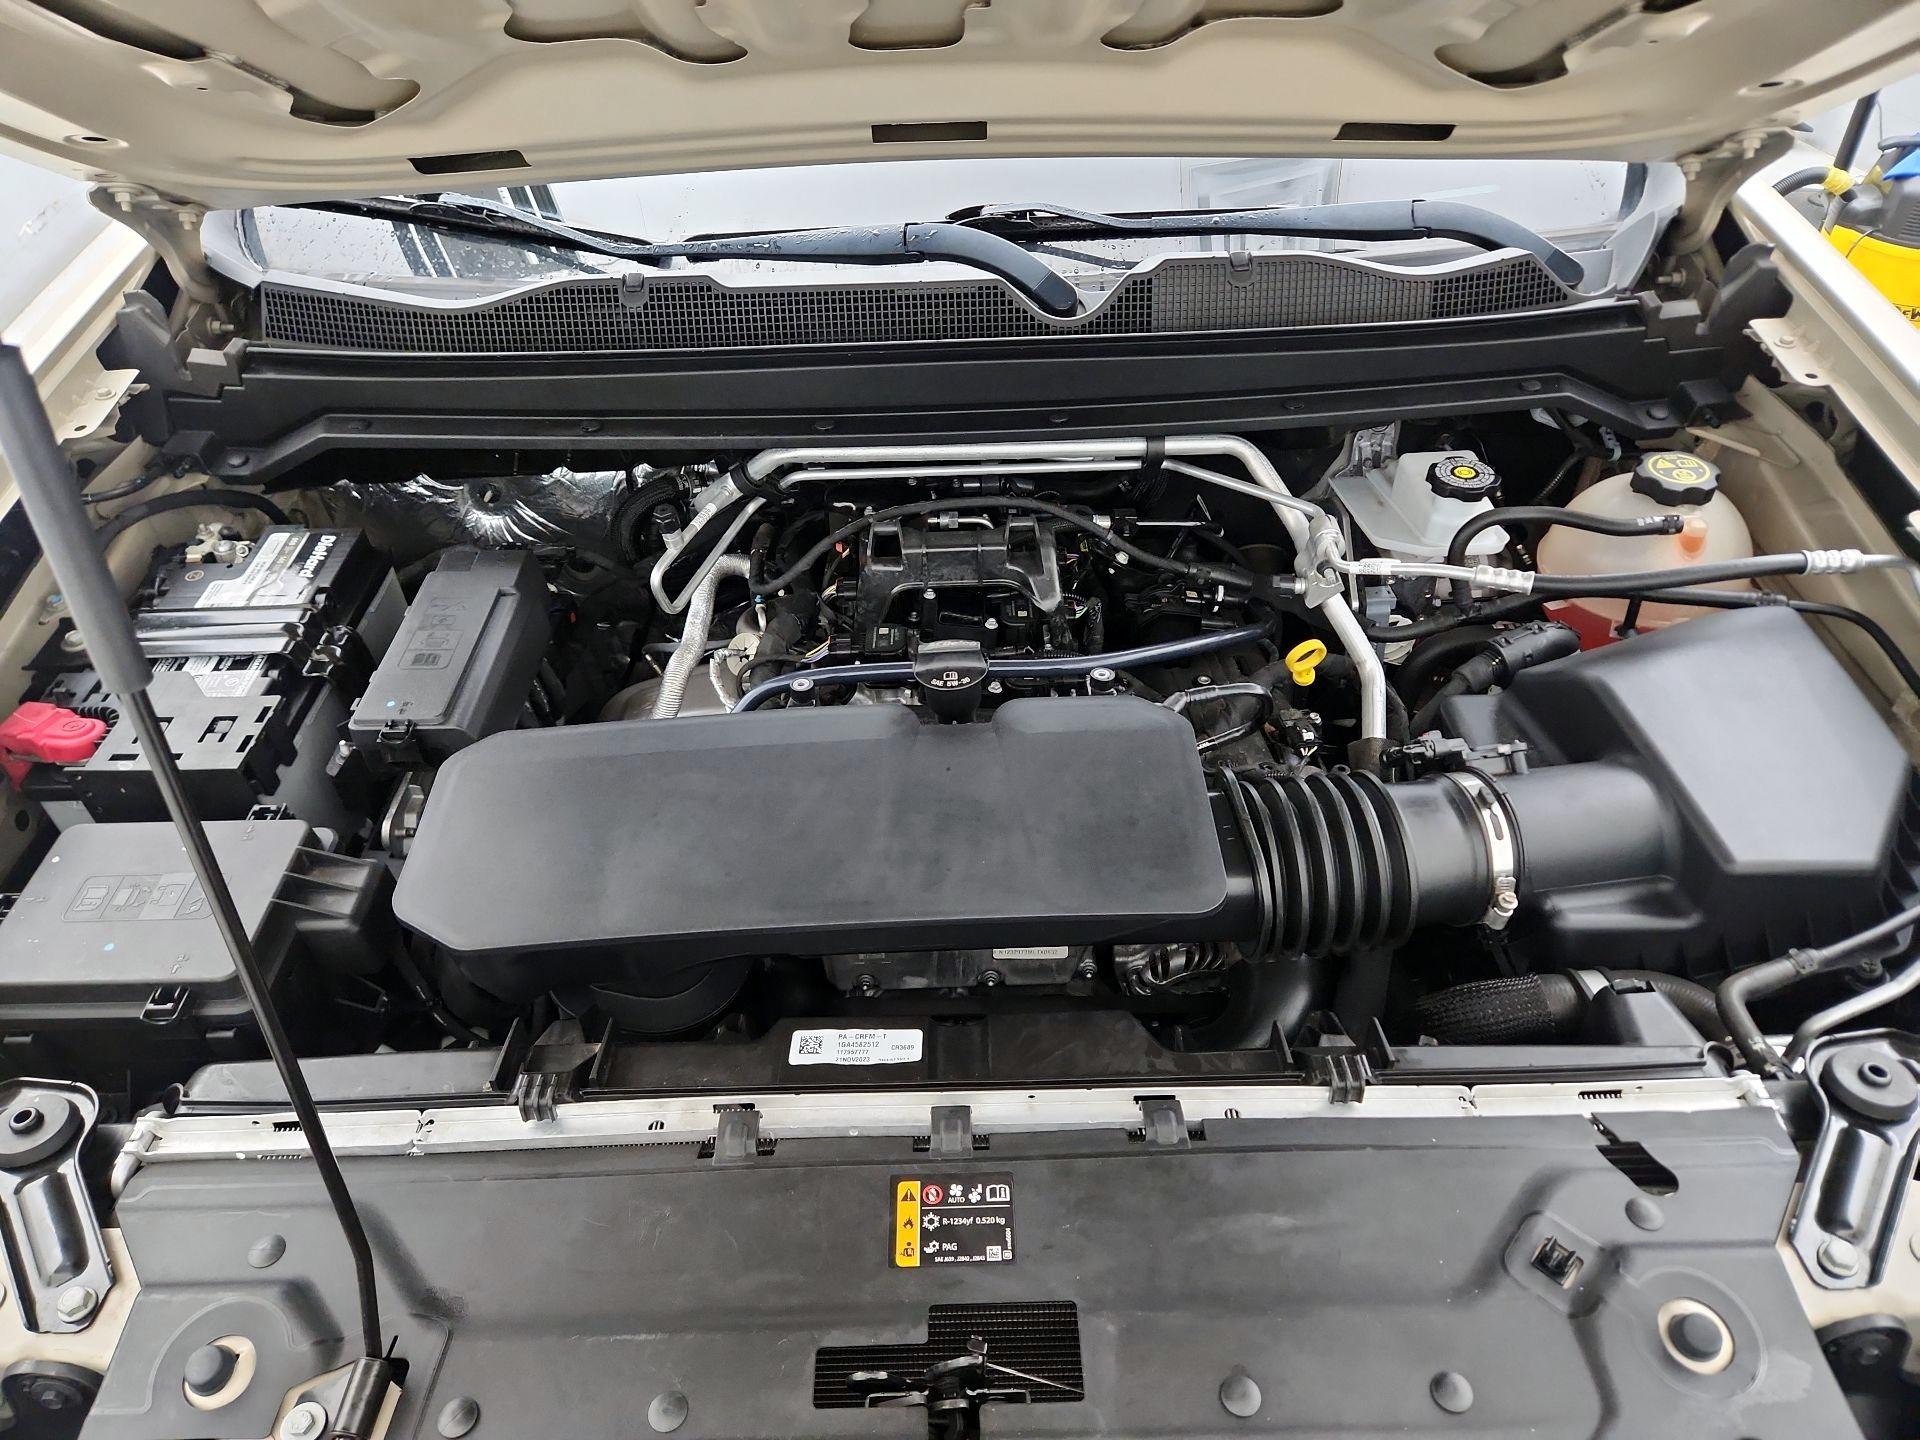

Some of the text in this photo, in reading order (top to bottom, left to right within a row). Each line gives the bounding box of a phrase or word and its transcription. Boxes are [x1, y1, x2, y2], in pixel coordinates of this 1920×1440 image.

[299, 534, 337, 578] DieHard
[930, 678, 944, 687] SAE
[947, 1196, 966, 1204] AUTO
[942, 1215, 1006, 1226] R-1234yf 0.520 kg
[942, 1242, 958, 1251] PAG
